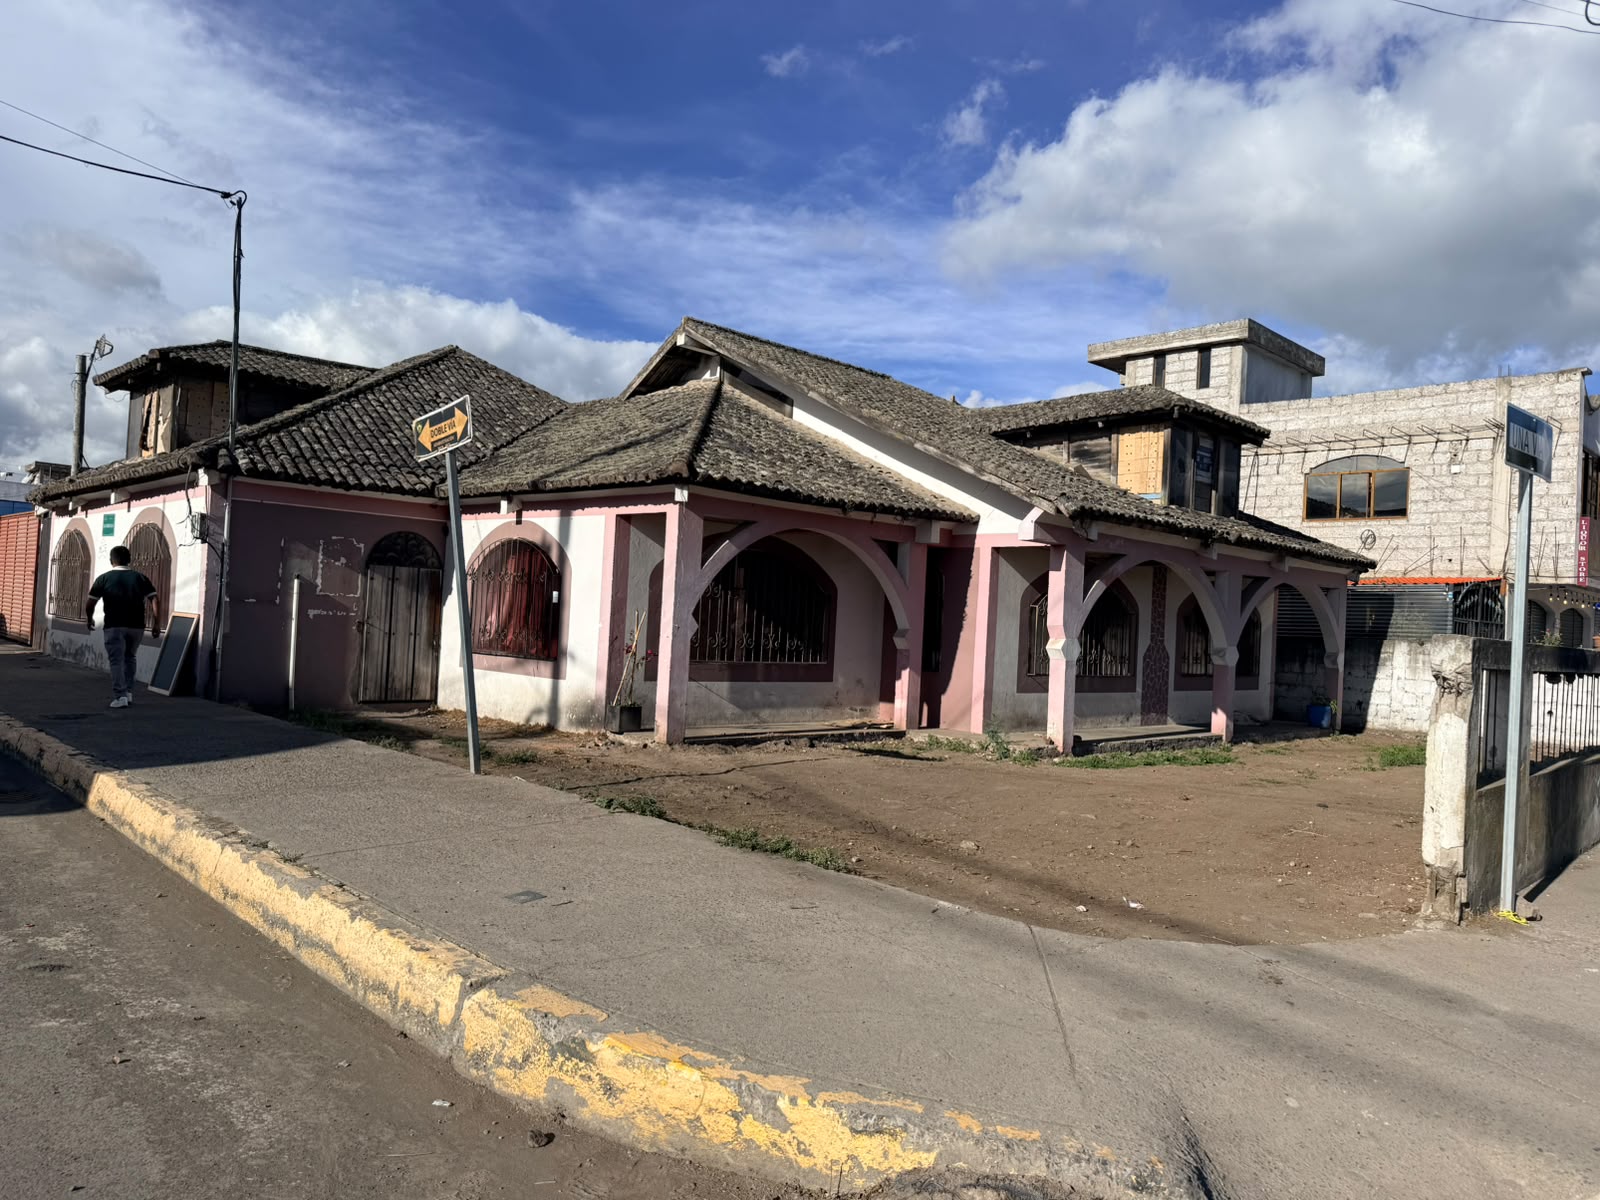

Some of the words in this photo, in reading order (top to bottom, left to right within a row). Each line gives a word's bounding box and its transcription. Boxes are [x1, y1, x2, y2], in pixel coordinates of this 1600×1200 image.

[430, 424, 447, 438] DOBLE
[1512, 424, 1530, 453] UNA
[1580, 519, 1588, 551] LIQUOR
